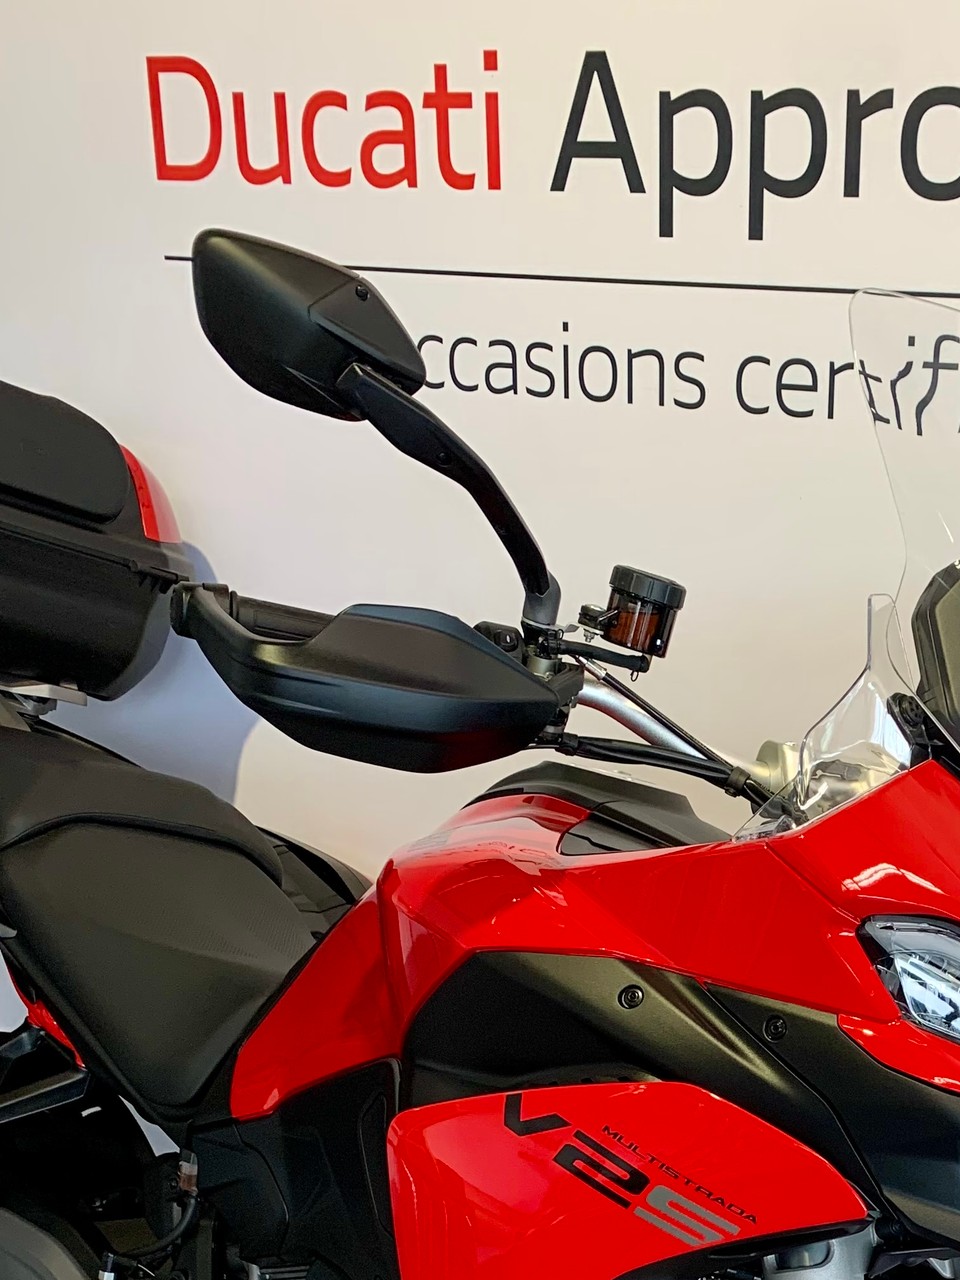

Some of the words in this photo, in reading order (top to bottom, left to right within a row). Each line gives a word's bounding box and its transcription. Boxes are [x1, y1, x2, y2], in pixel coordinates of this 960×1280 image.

[146, 49, 502, 191] Ducati
[416, 320, 706, 410] ccasions
[601, 1124, 758, 1225] MULTISTRADA
